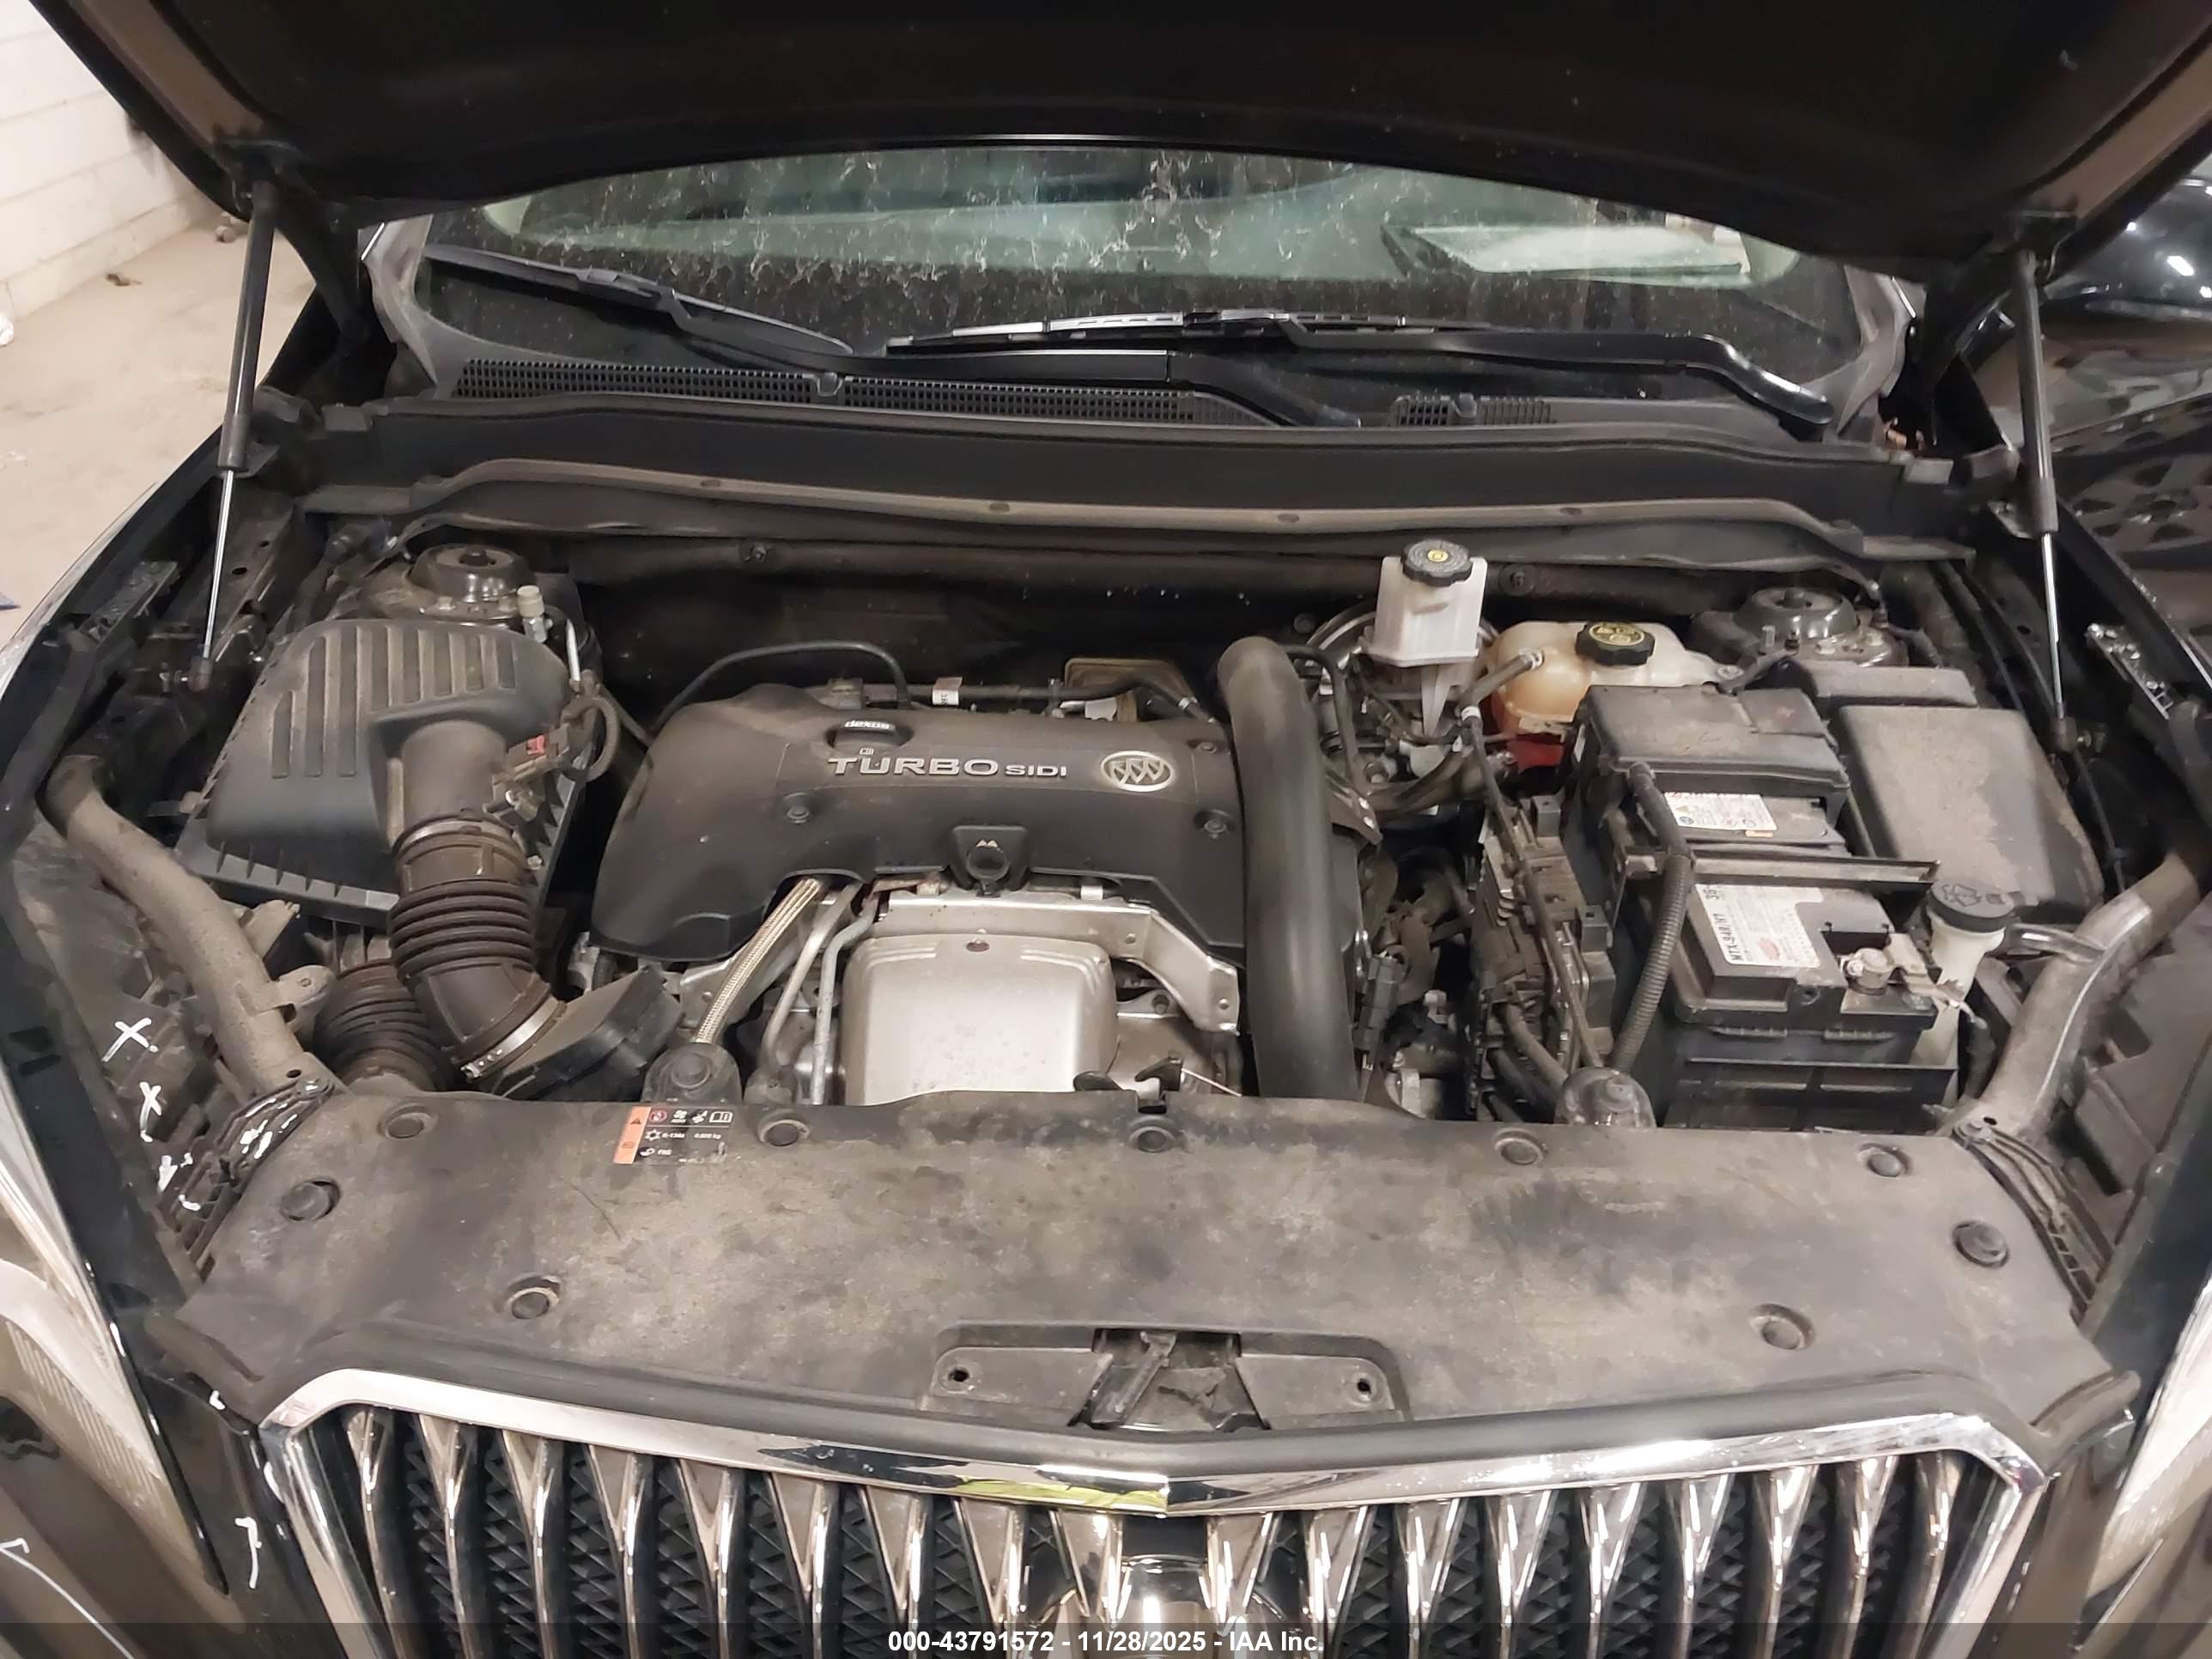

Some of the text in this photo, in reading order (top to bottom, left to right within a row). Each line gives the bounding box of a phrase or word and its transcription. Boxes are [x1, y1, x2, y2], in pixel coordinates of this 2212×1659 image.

[845, 720, 890, 729] dexos
[827, 757, 1066, 777] TURBO SIDI
